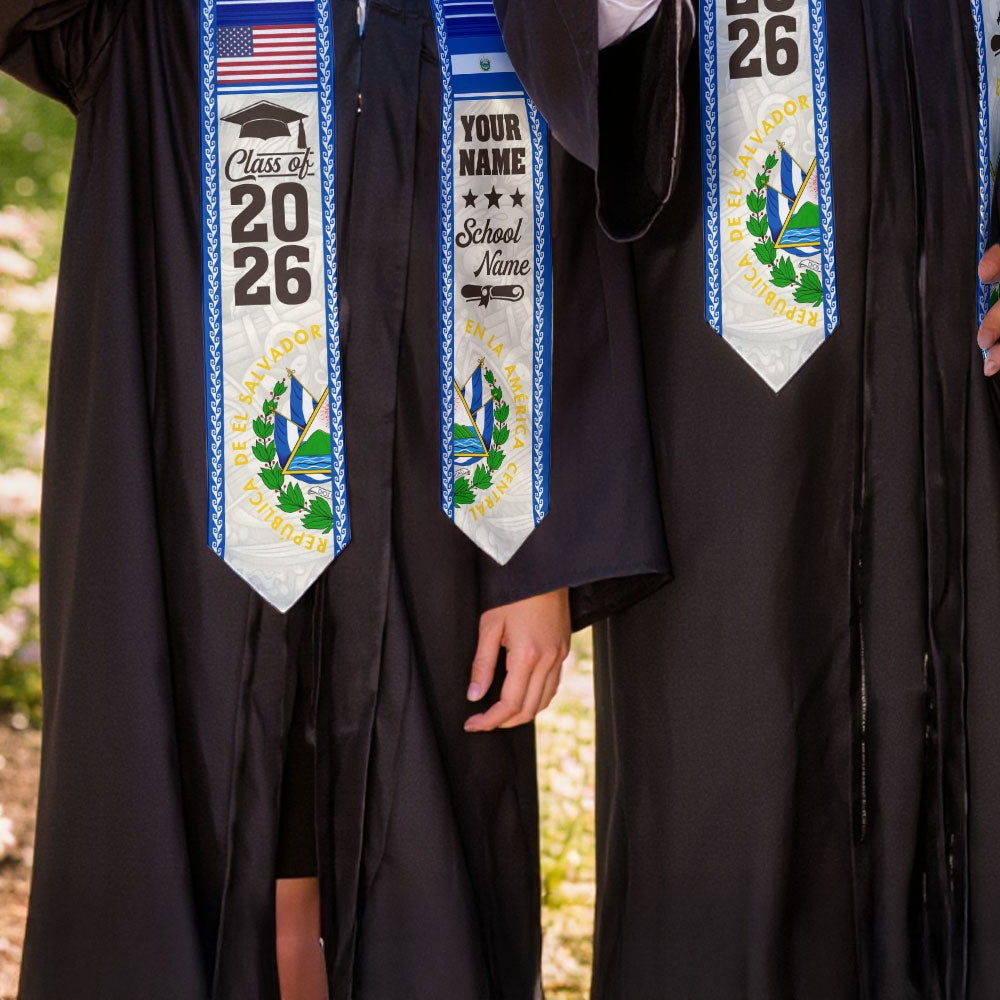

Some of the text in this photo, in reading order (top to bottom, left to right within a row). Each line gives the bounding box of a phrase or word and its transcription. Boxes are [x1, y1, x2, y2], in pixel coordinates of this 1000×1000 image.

[728, 15, 799, 79] 26
[460, 113, 521, 142] YOUR
[225, 147, 314, 182] Class of
[459, 148, 526, 176] NAME
[230, 182, 309, 243] 20
[455, 218, 523, 248] School
[728, 94, 819, 328] REPÚBLICA DE EL SALVADOR
[233, 245, 312, 306] 26
[474, 250, 530, 277] Name
[232, 324, 328, 553] REPÚBLICA DE EL SALVADOR
[464, 319, 527, 521] EN LA AMÉRICA CENTRAL
